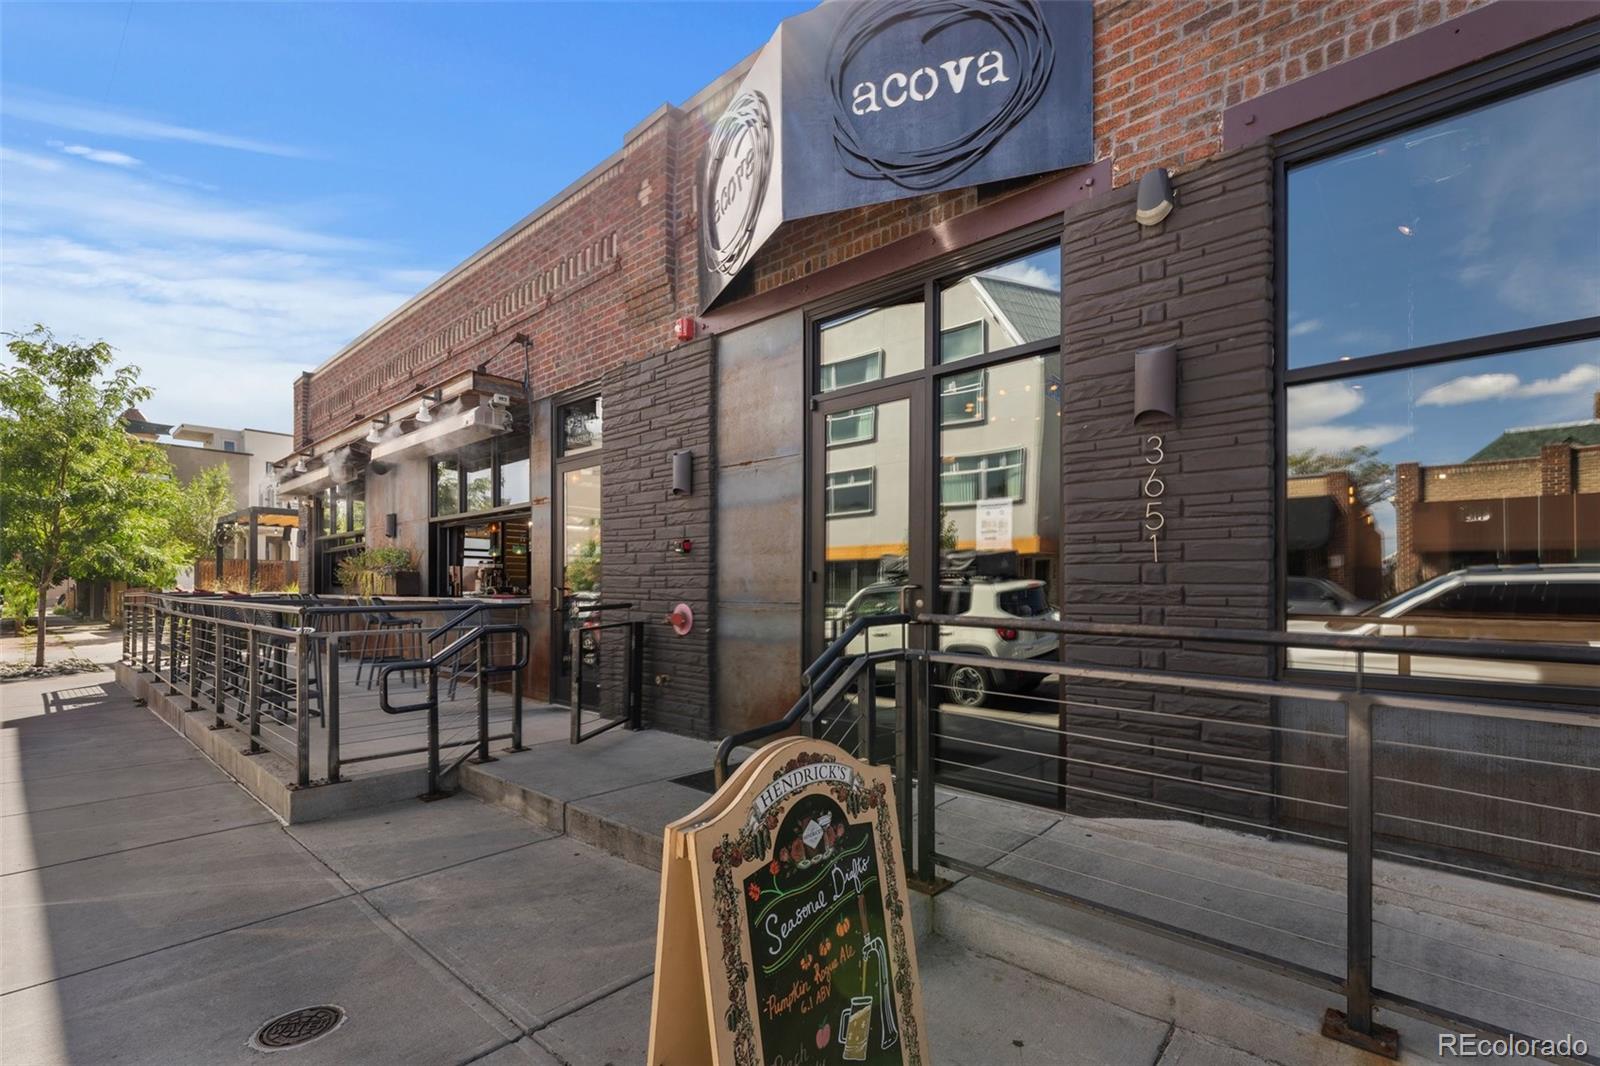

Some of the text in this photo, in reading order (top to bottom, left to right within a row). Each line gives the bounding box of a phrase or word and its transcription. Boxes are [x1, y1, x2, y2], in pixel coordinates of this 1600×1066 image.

[852, 50, 1010, 115] acova
[1144, 435, 1165, 562] 3651
[760, 764, 847, 808] HENDRICK'S
[765, 890, 828, 955] Seasonal
[270, 1014, 330, 1036] WATER
